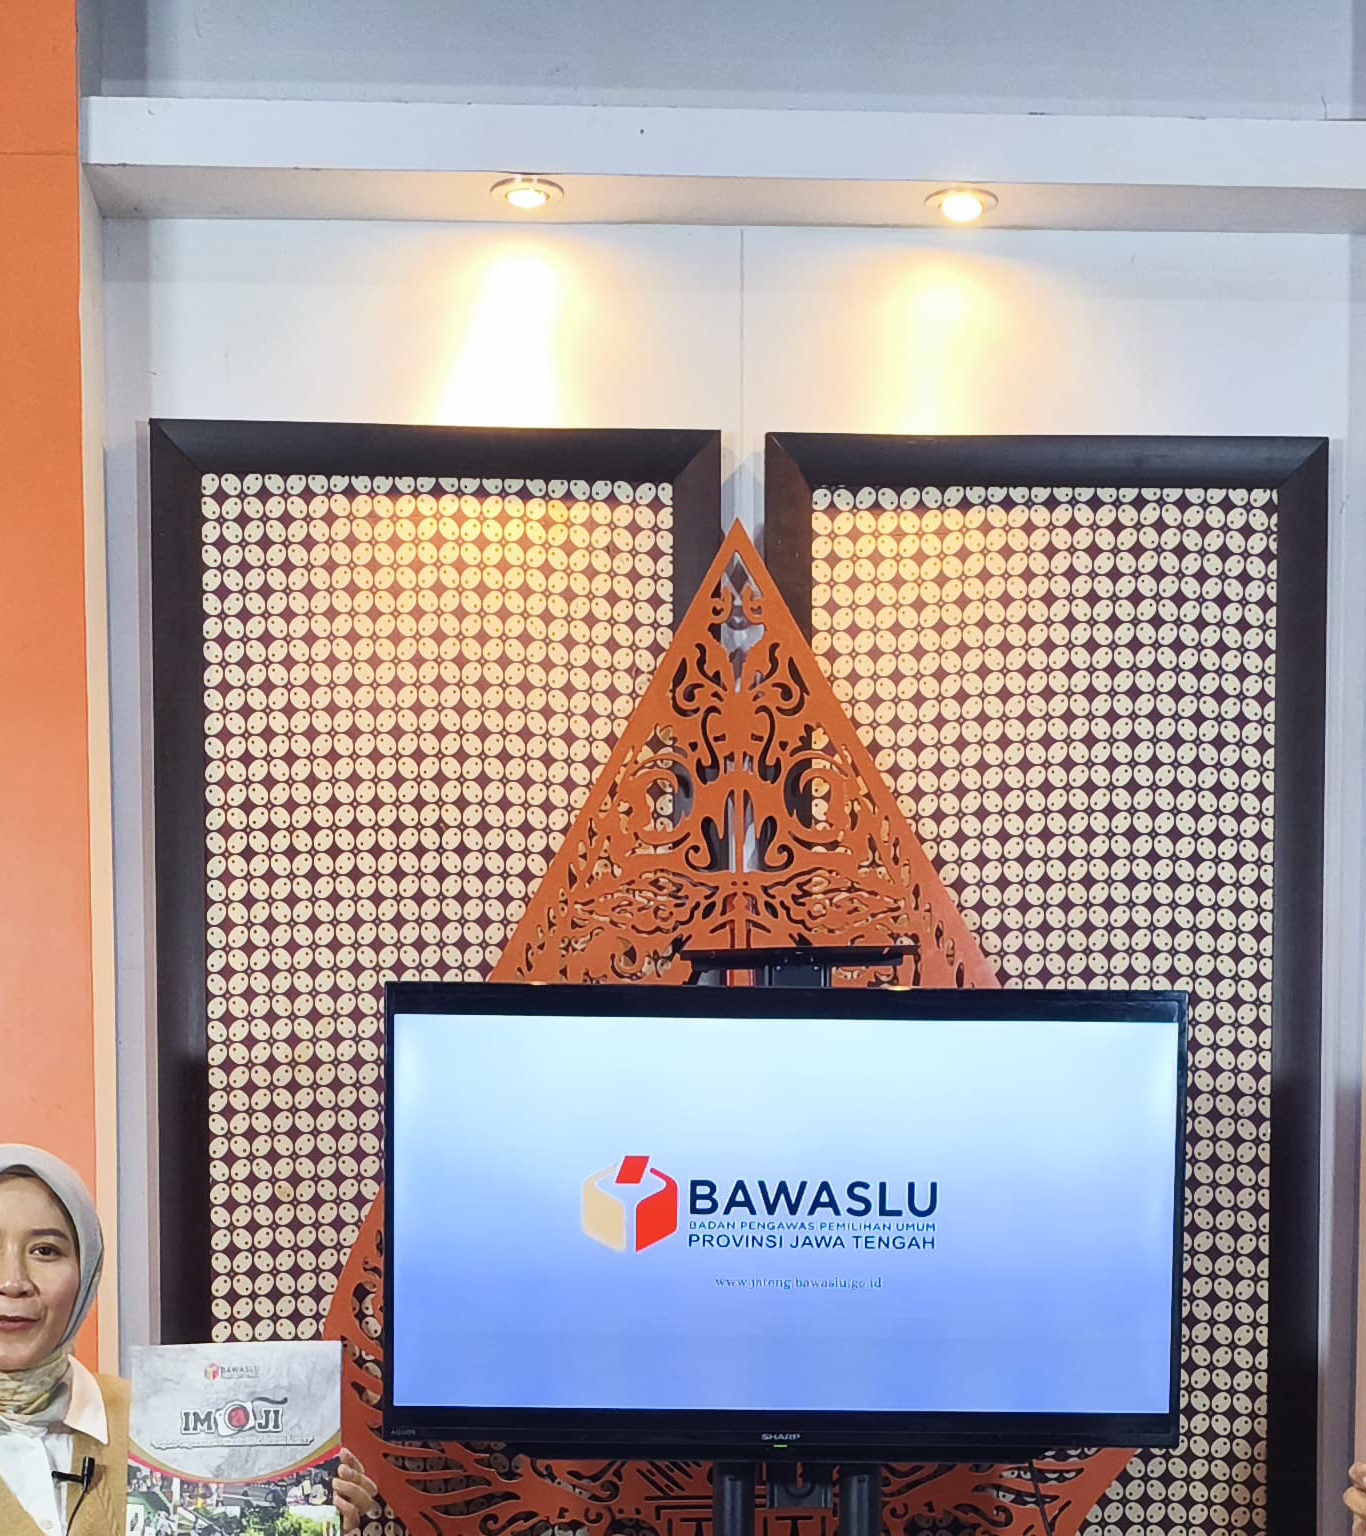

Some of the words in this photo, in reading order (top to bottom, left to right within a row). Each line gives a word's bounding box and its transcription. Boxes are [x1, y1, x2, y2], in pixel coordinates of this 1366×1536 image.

[689, 1179, 938, 1218] BAWASLU
[689, 1221, 736, 1231] BADAN
[740, 1221, 815, 1231] PENGAWAS
[819, 1222, 892, 1232] PEMILIHAN
[896, 1222, 936, 1232] UMUM
[688, 1233, 783, 1249] PROVINSI
[789, 1234, 845, 1249] JAWA
[851, 1235, 936, 1250] TENGAH
